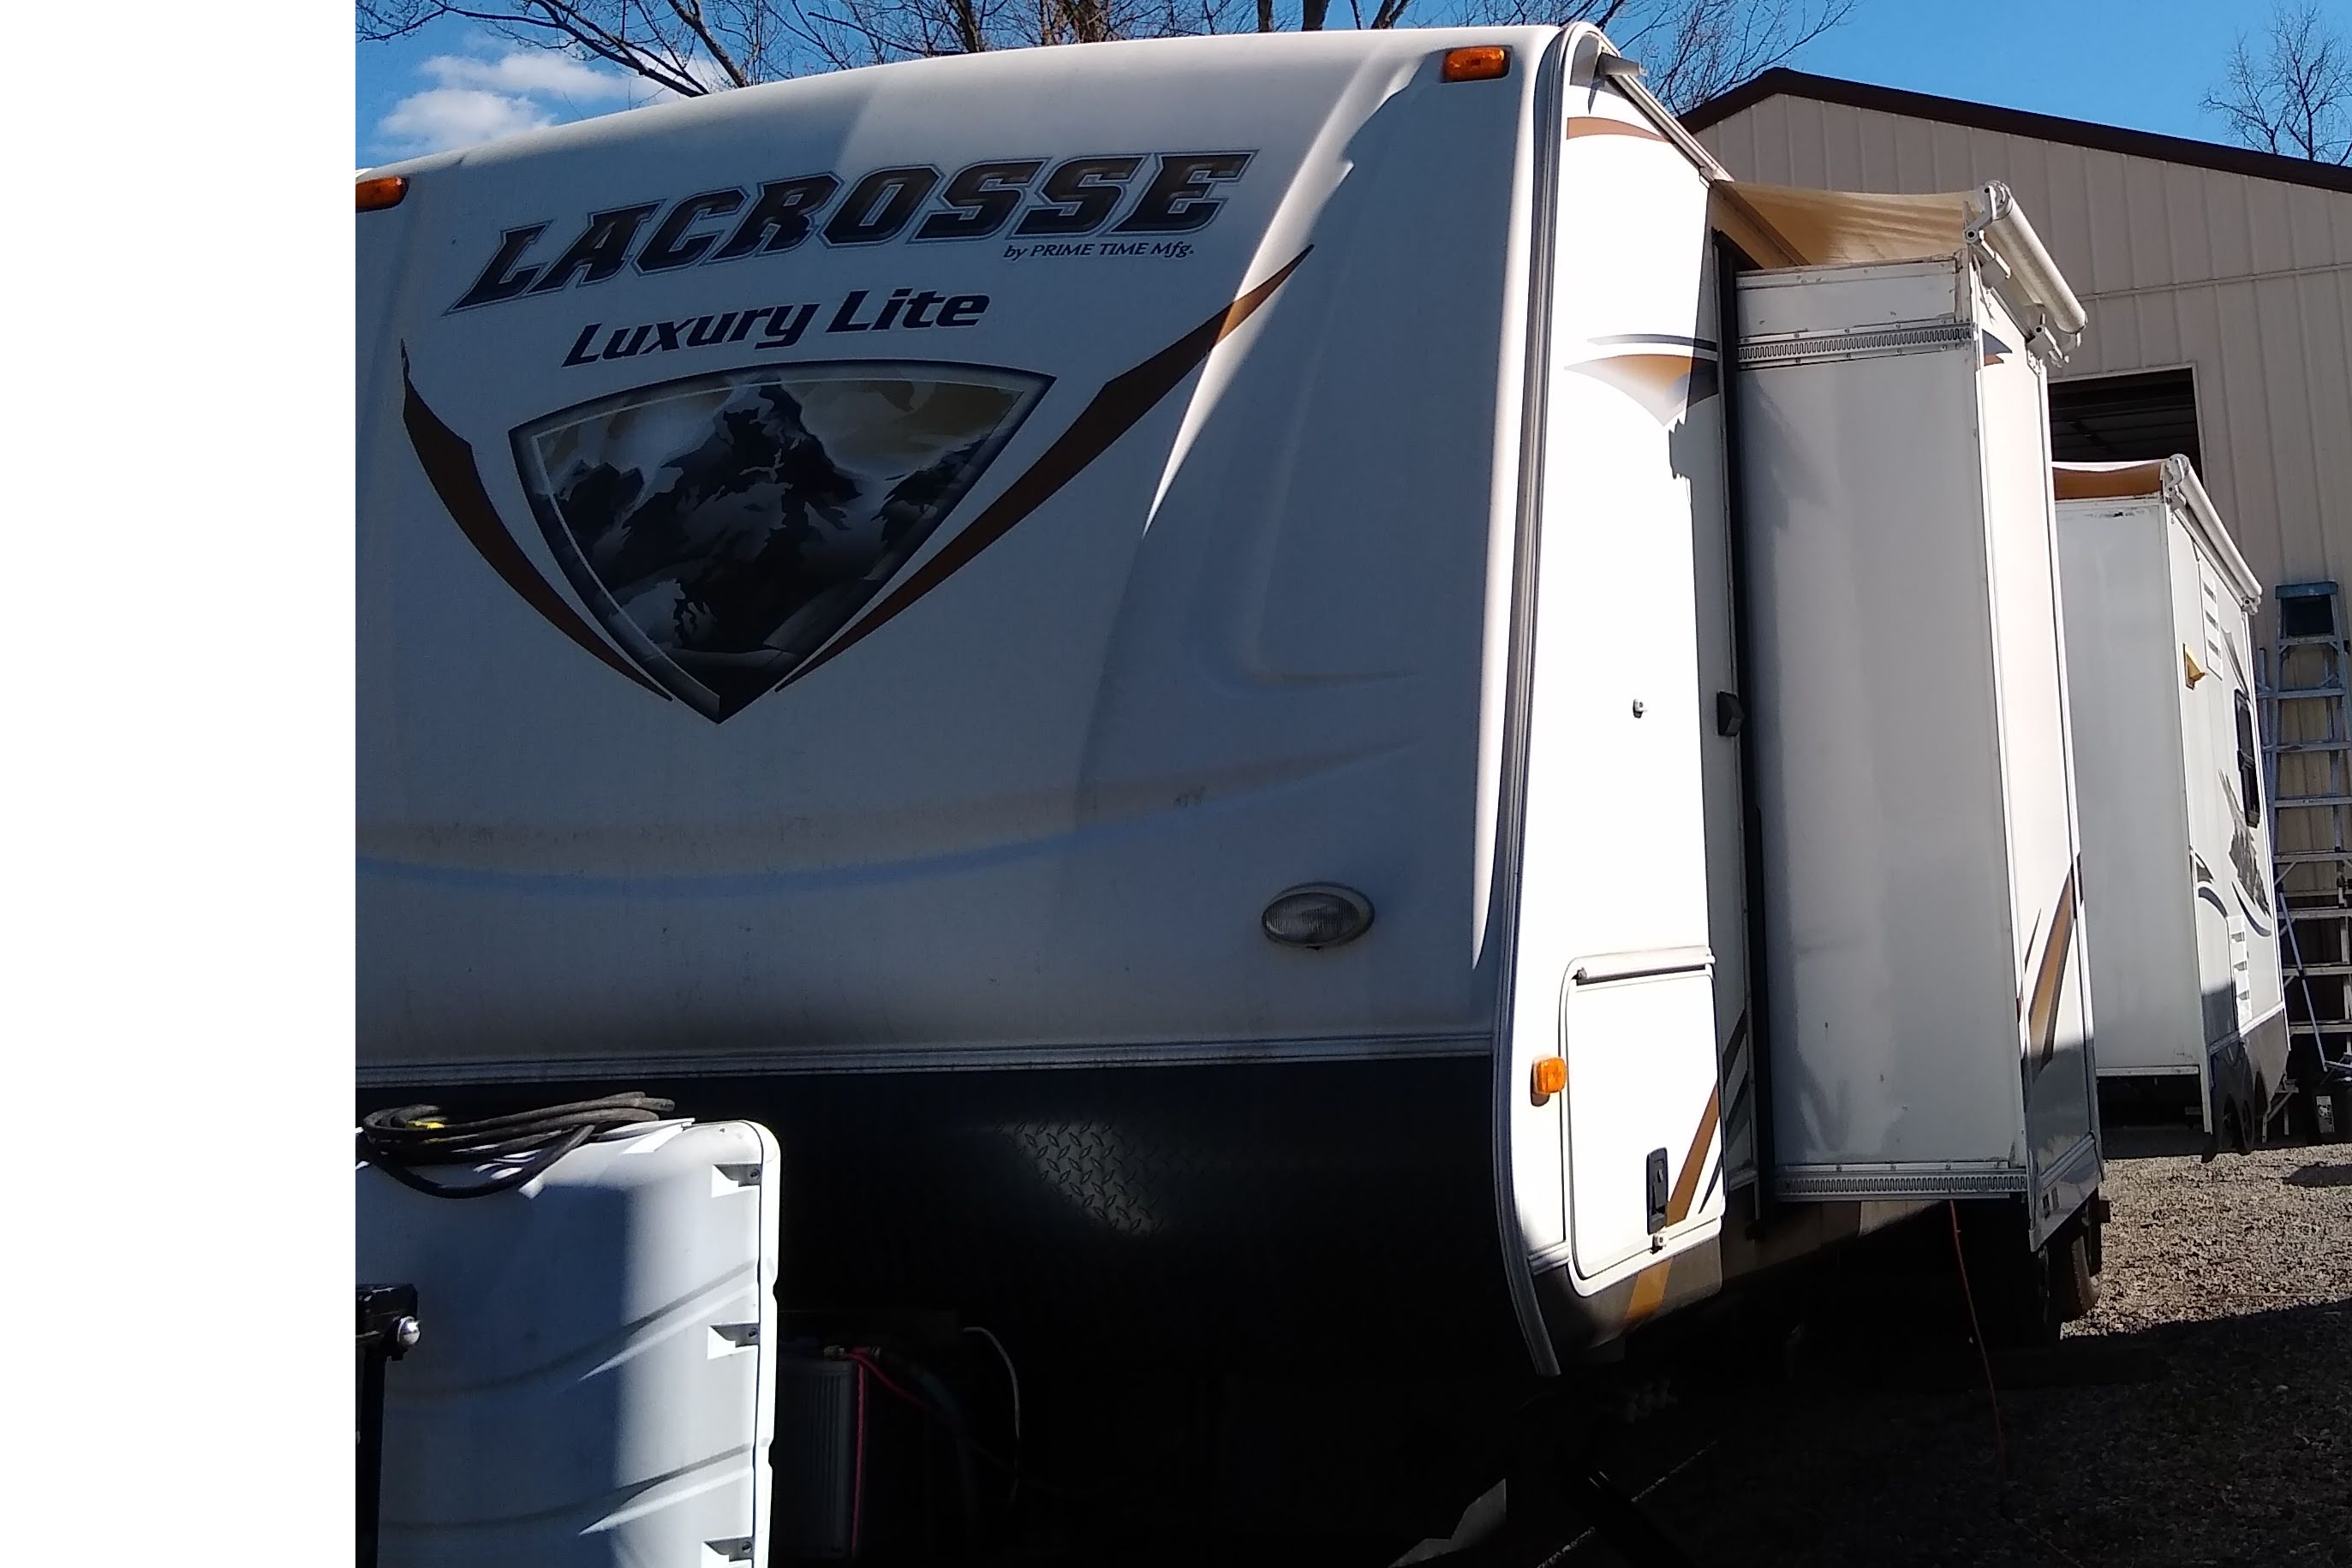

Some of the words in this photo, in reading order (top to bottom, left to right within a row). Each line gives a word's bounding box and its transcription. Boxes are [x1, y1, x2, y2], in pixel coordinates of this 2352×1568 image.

[444, 149, 1259, 314] LACROSSE
[1003, 245, 1029, 261] by
[1030, 243, 1095, 257] PRIME
[1100, 242, 1149, 255] TIME
[560, 302, 821, 368] Luxury
[825, 287, 991, 333] Lite
